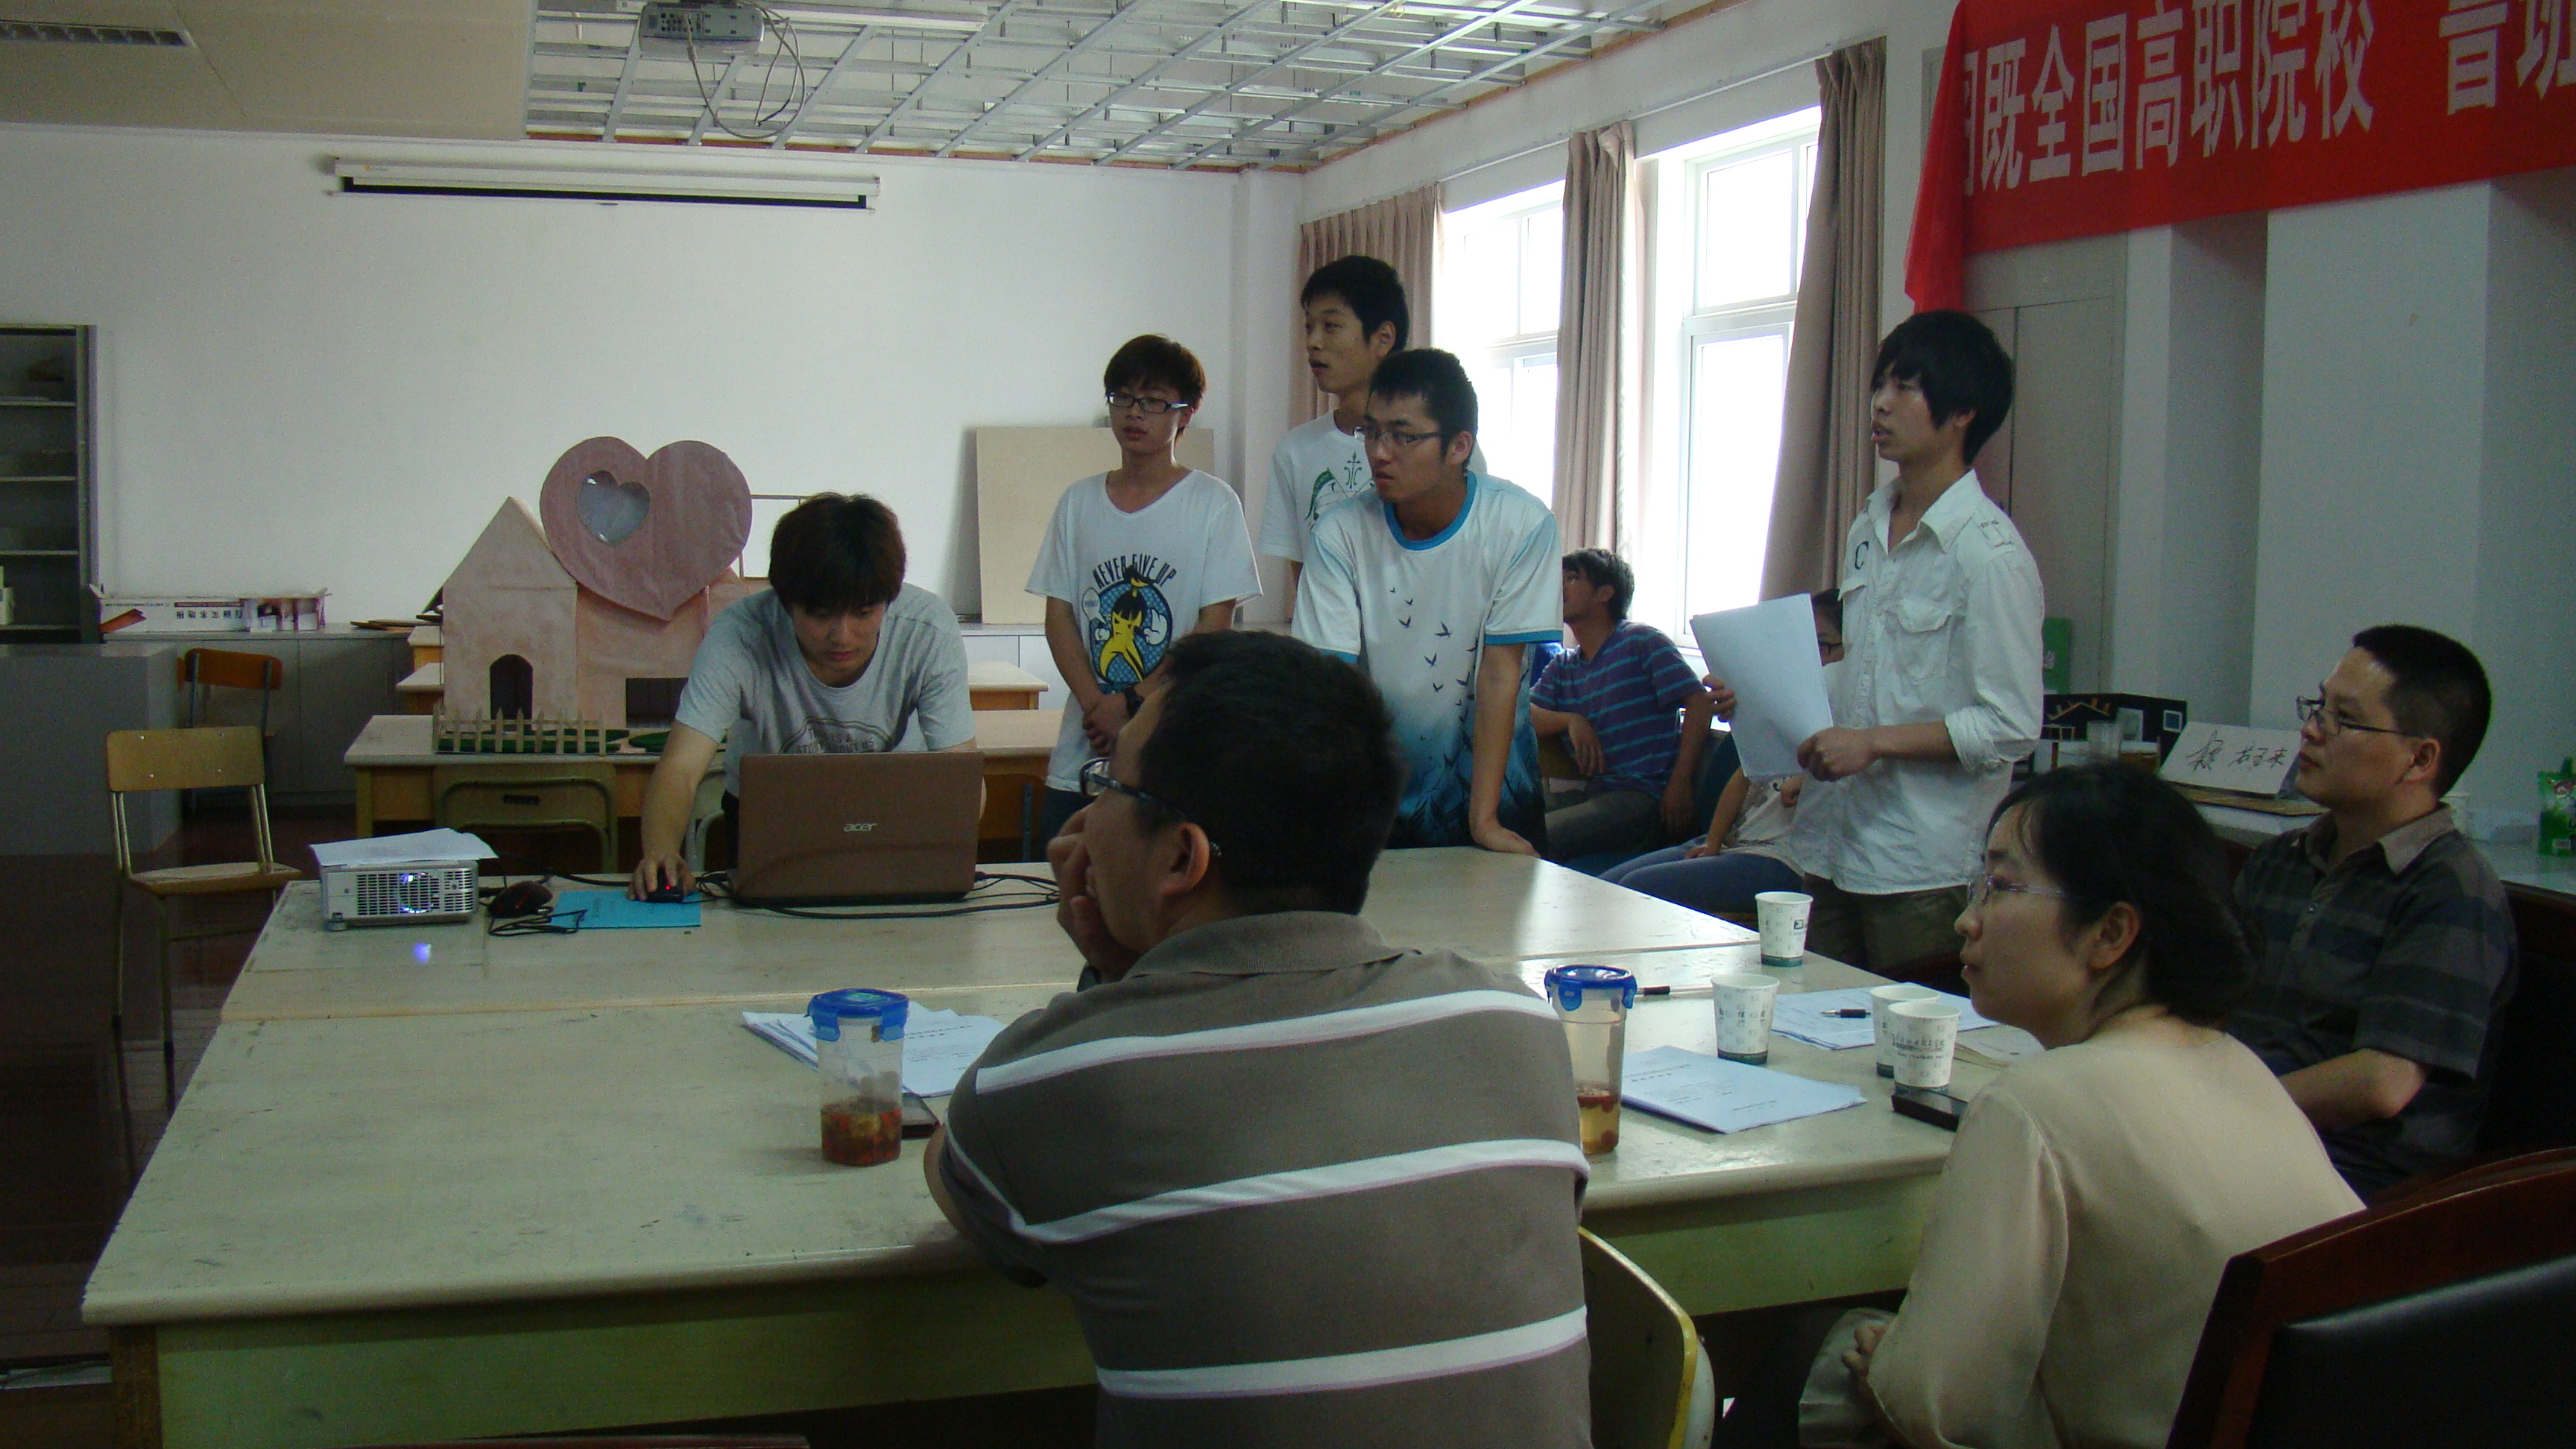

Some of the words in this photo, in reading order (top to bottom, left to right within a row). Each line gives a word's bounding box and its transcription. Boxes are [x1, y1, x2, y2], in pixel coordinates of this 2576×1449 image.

[1092, 555, 1127, 589] NEVER
[1131, 553, 1159, 579] GIVE
[1155, 562, 1177, 588] UP
[843, 822, 878, 833] acer
